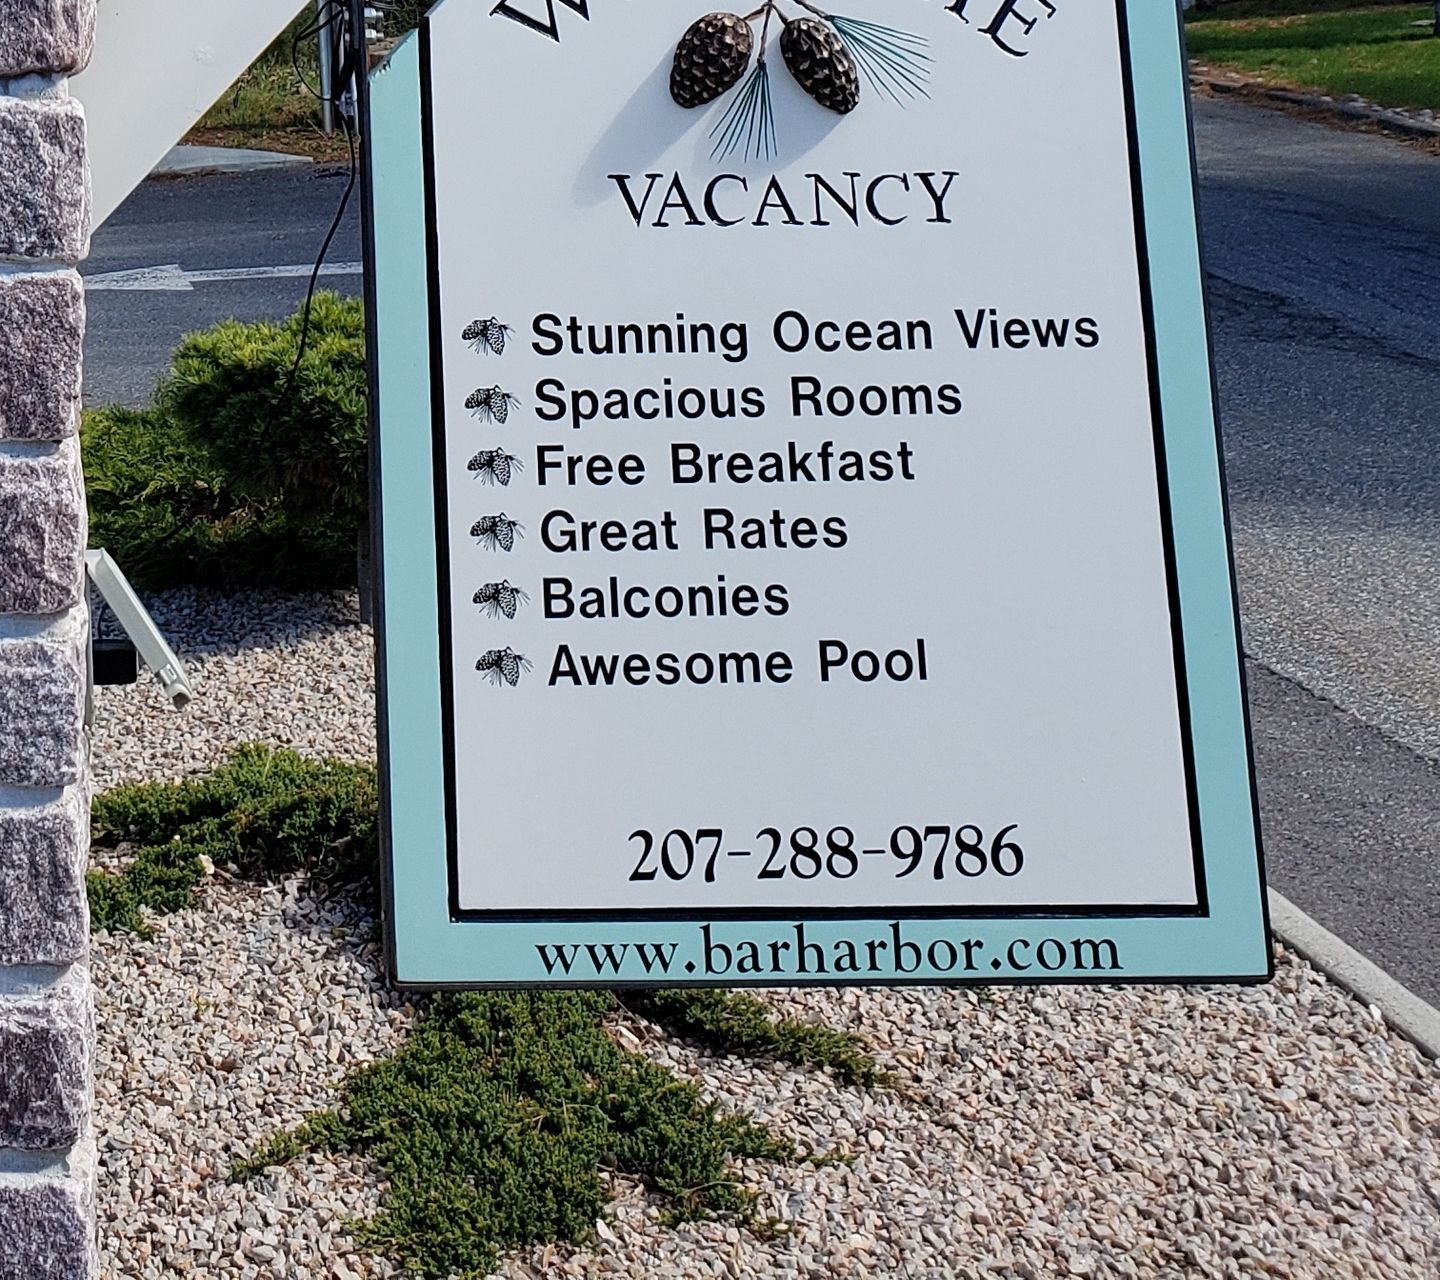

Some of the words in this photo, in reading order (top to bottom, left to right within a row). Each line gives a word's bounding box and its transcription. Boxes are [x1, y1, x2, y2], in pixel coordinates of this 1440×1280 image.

[606, 170, 961, 228] VACANCY
[531, 312, 748, 363] Stunning
[773, 310, 933, 353] Ocean
[953, 308, 1100, 349] Views
[534, 377, 766, 429] Spacious
[790, 375, 962, 417] Rooms
[536, 444, 646, 486] Free
[670, 440, 915, 484] Breakfast
[540, 509, 679, 553] Great
[703, 508, 848, 550] Rates
[542, 574, 790, 619] Balconies
[548, 644, 793, 687] Awesome
[818, 638, 928, 682] Pool
[628, 824, 1024, 883] 207-288-9786
[534, 920, 1125, 976] www.barharbor.com
